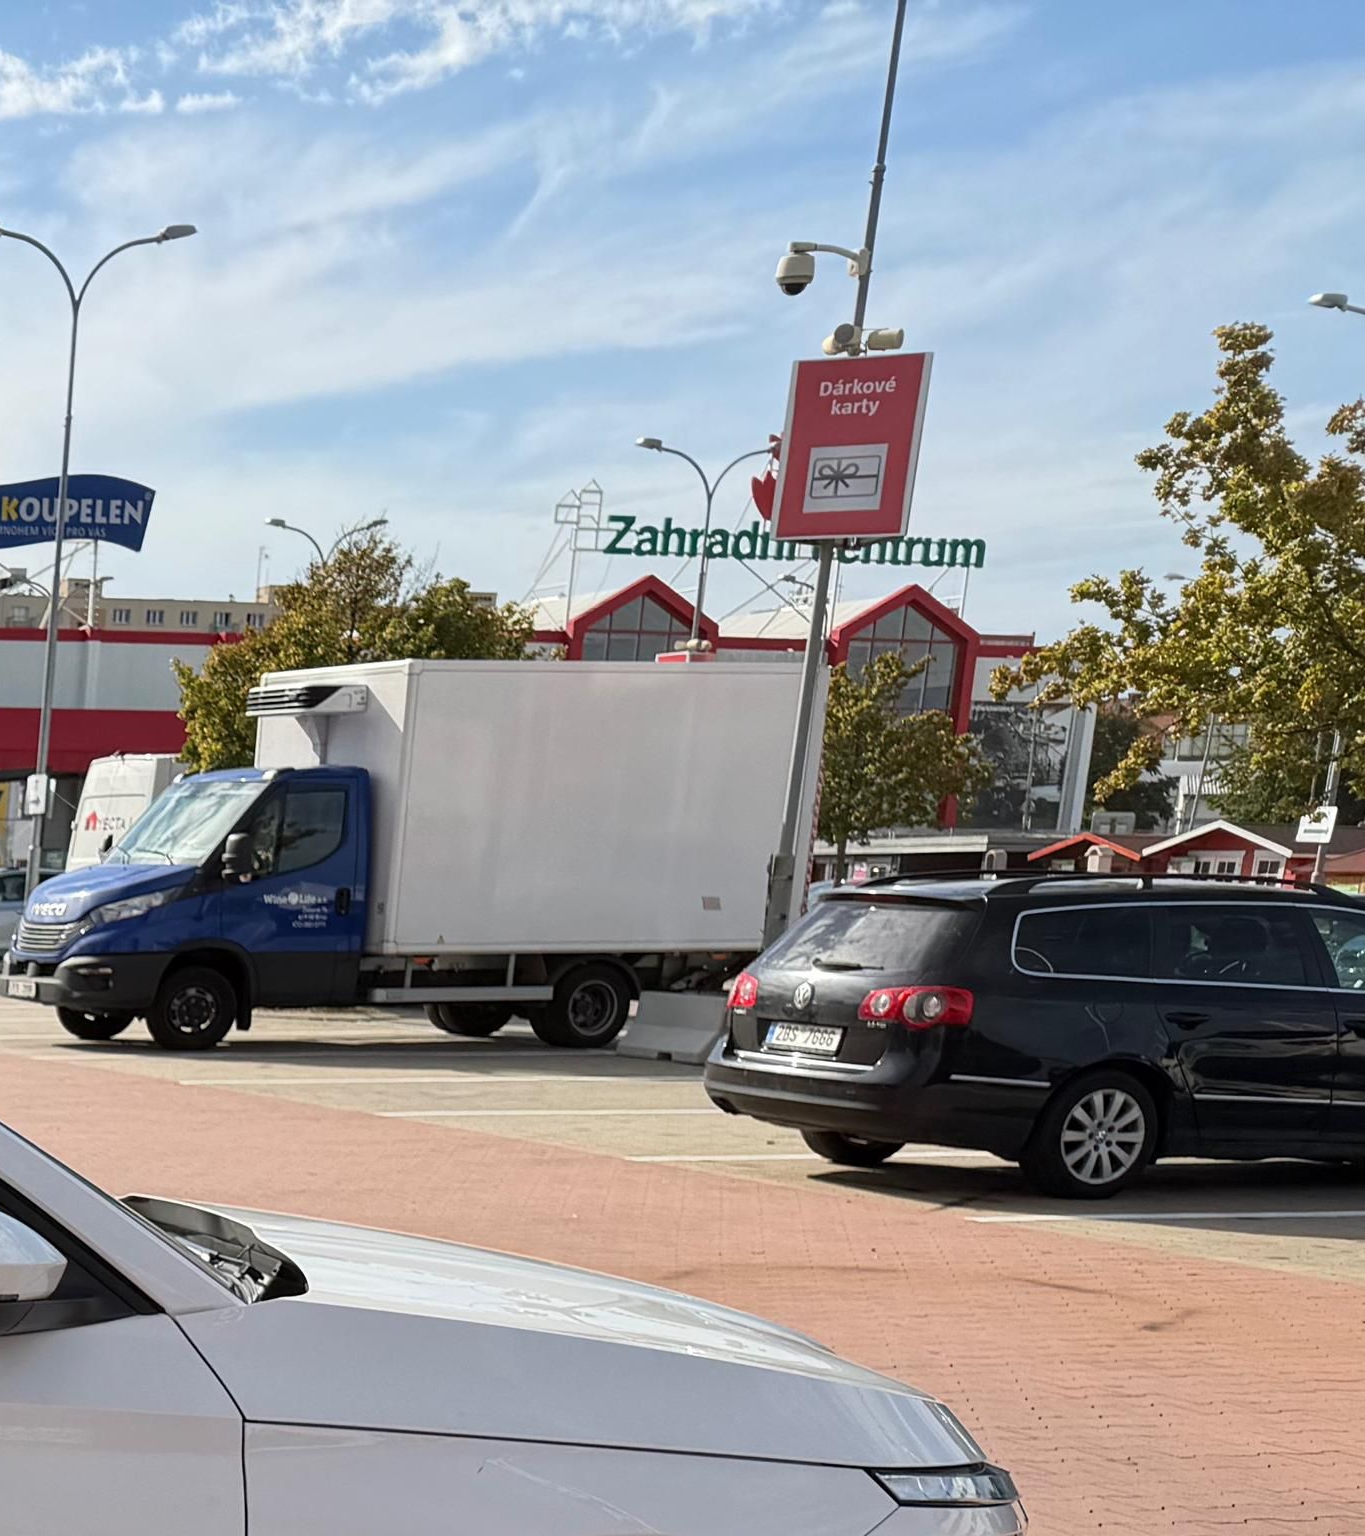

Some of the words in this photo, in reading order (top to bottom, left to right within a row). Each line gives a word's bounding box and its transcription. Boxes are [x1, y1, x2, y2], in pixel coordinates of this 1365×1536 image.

[819, 376, 897, 397] Dárkové
[830, 398, 880, 417] karty
[0, 494, 144, 525] KOUPELEN
[42, 523, 59, 537] VÍC
[66, 525, 86, 538] PRO
[837, 535, 987, 568] entrum
[31, 902, 68, 916] IVECO
